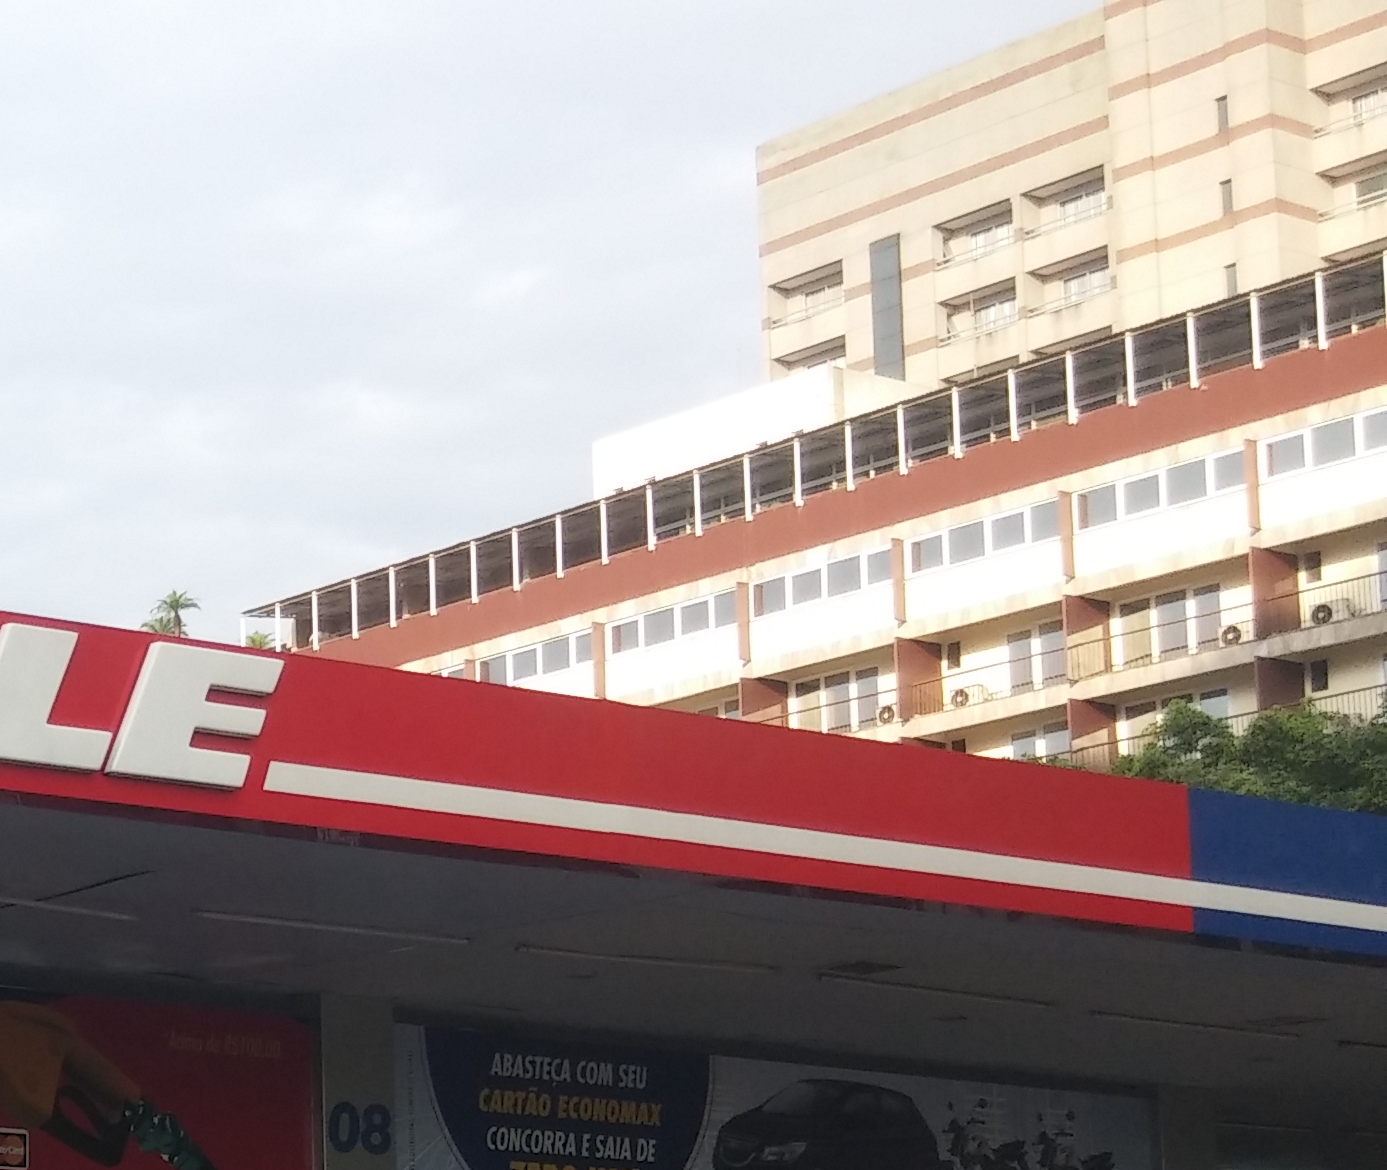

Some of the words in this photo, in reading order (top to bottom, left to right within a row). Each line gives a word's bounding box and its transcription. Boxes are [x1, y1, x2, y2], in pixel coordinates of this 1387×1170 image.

[491, 1053, 571, 1087] ABASTEÇA
[577, 1060, 613, 1087] COM
[618, 1064, 647, 1089] SEU
[479, 1086, 550, 1116] CARTÃO
[557, 1097, 661, 1126] ECONOMAX
[329, 1101, 391, 1154] 08
[487, 1125, 576, 1155] CONCORRA
[581, 1134, 590, 1154] E
[595, 1134, 634, 1160] SAIA
[636, 1138, 656, 1163] DE
